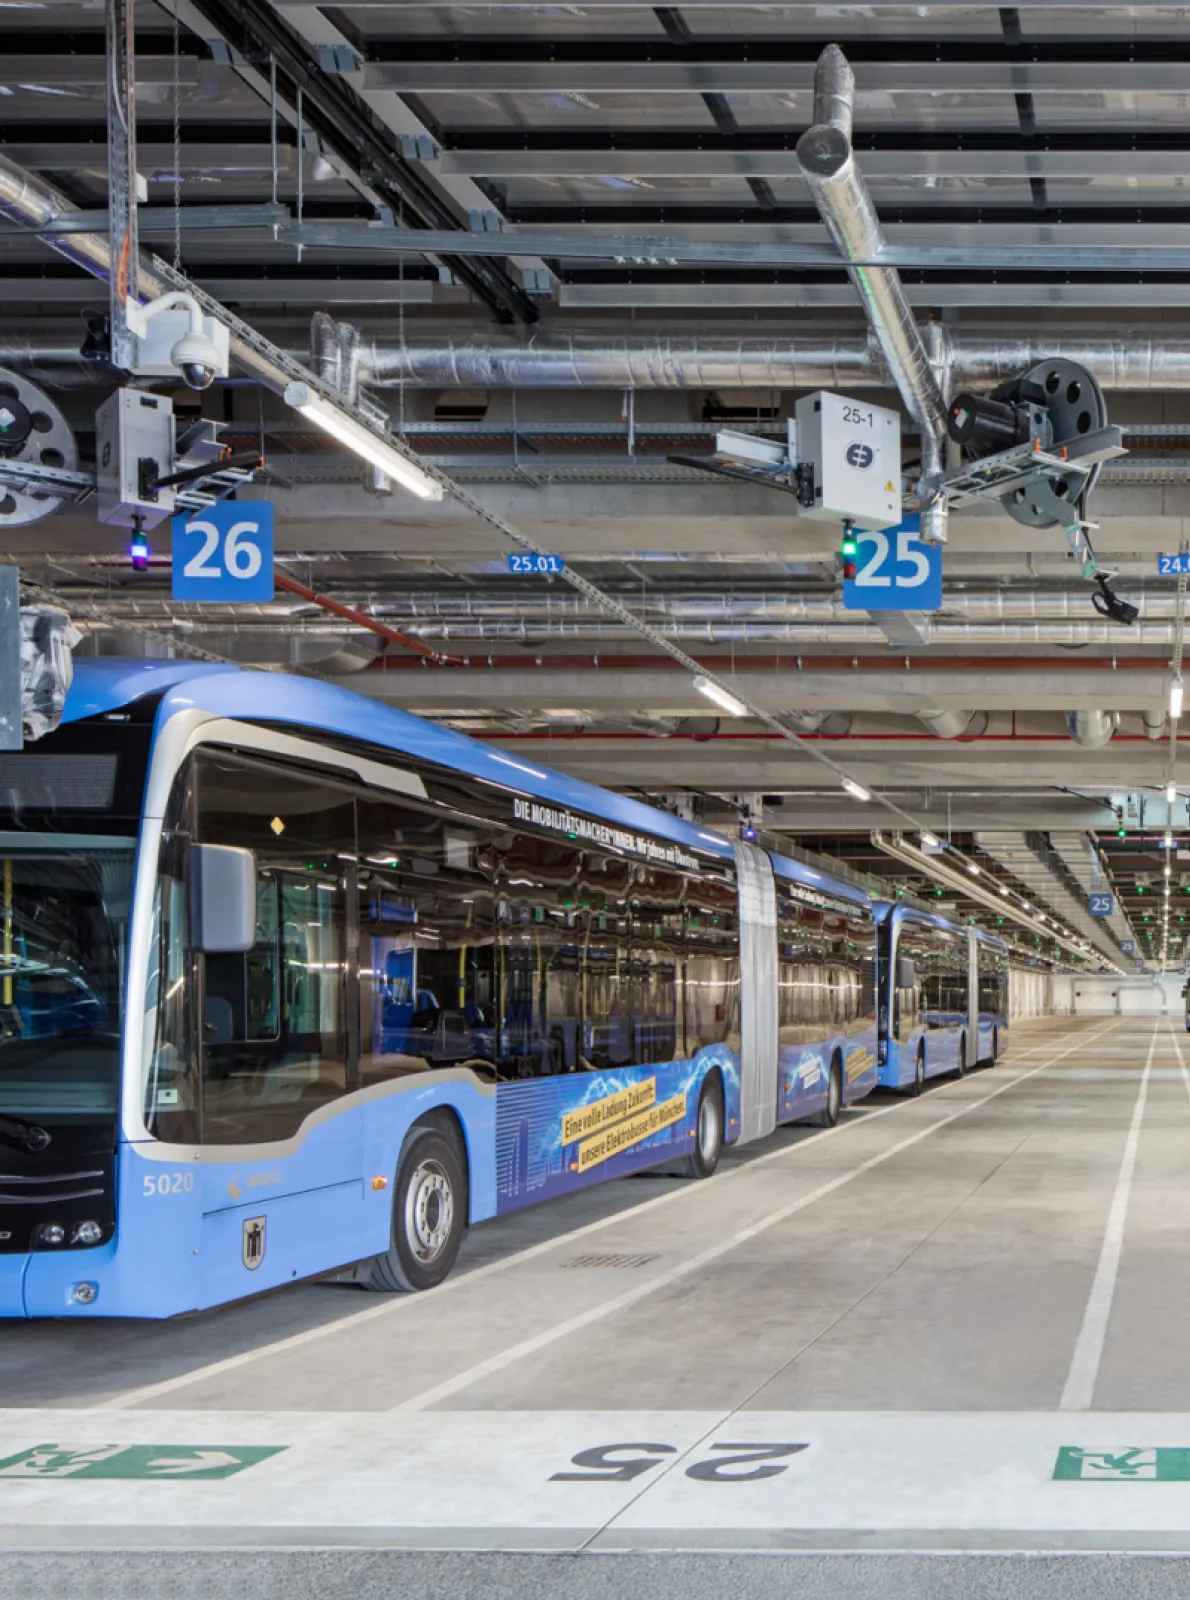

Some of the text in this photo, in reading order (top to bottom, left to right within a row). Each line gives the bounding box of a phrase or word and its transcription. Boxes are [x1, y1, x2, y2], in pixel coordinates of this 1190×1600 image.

[843, 406, 873, 427] 25-1
[185, 521, 261, 578] 26
[511, 556, 559, 571] 25.01
[855, 531, 930, 587] 25
[514, 798, 530, 820] DIE
[1092, 899, 1110, 911] 25
[565, 1117, 583, 1139] Eine
[583, 1105, 601, 1131] volle
[602, 1097, 628, 1120] Ladung
[581, 1142, 605, 1165] unsere
[606, 1119, 649, 1152] Elektrobusse
[649, 1110, 659, 1127] für
[143, 1171, 194, 1197] 5020
[547, 1442, 811, 1482] 25
